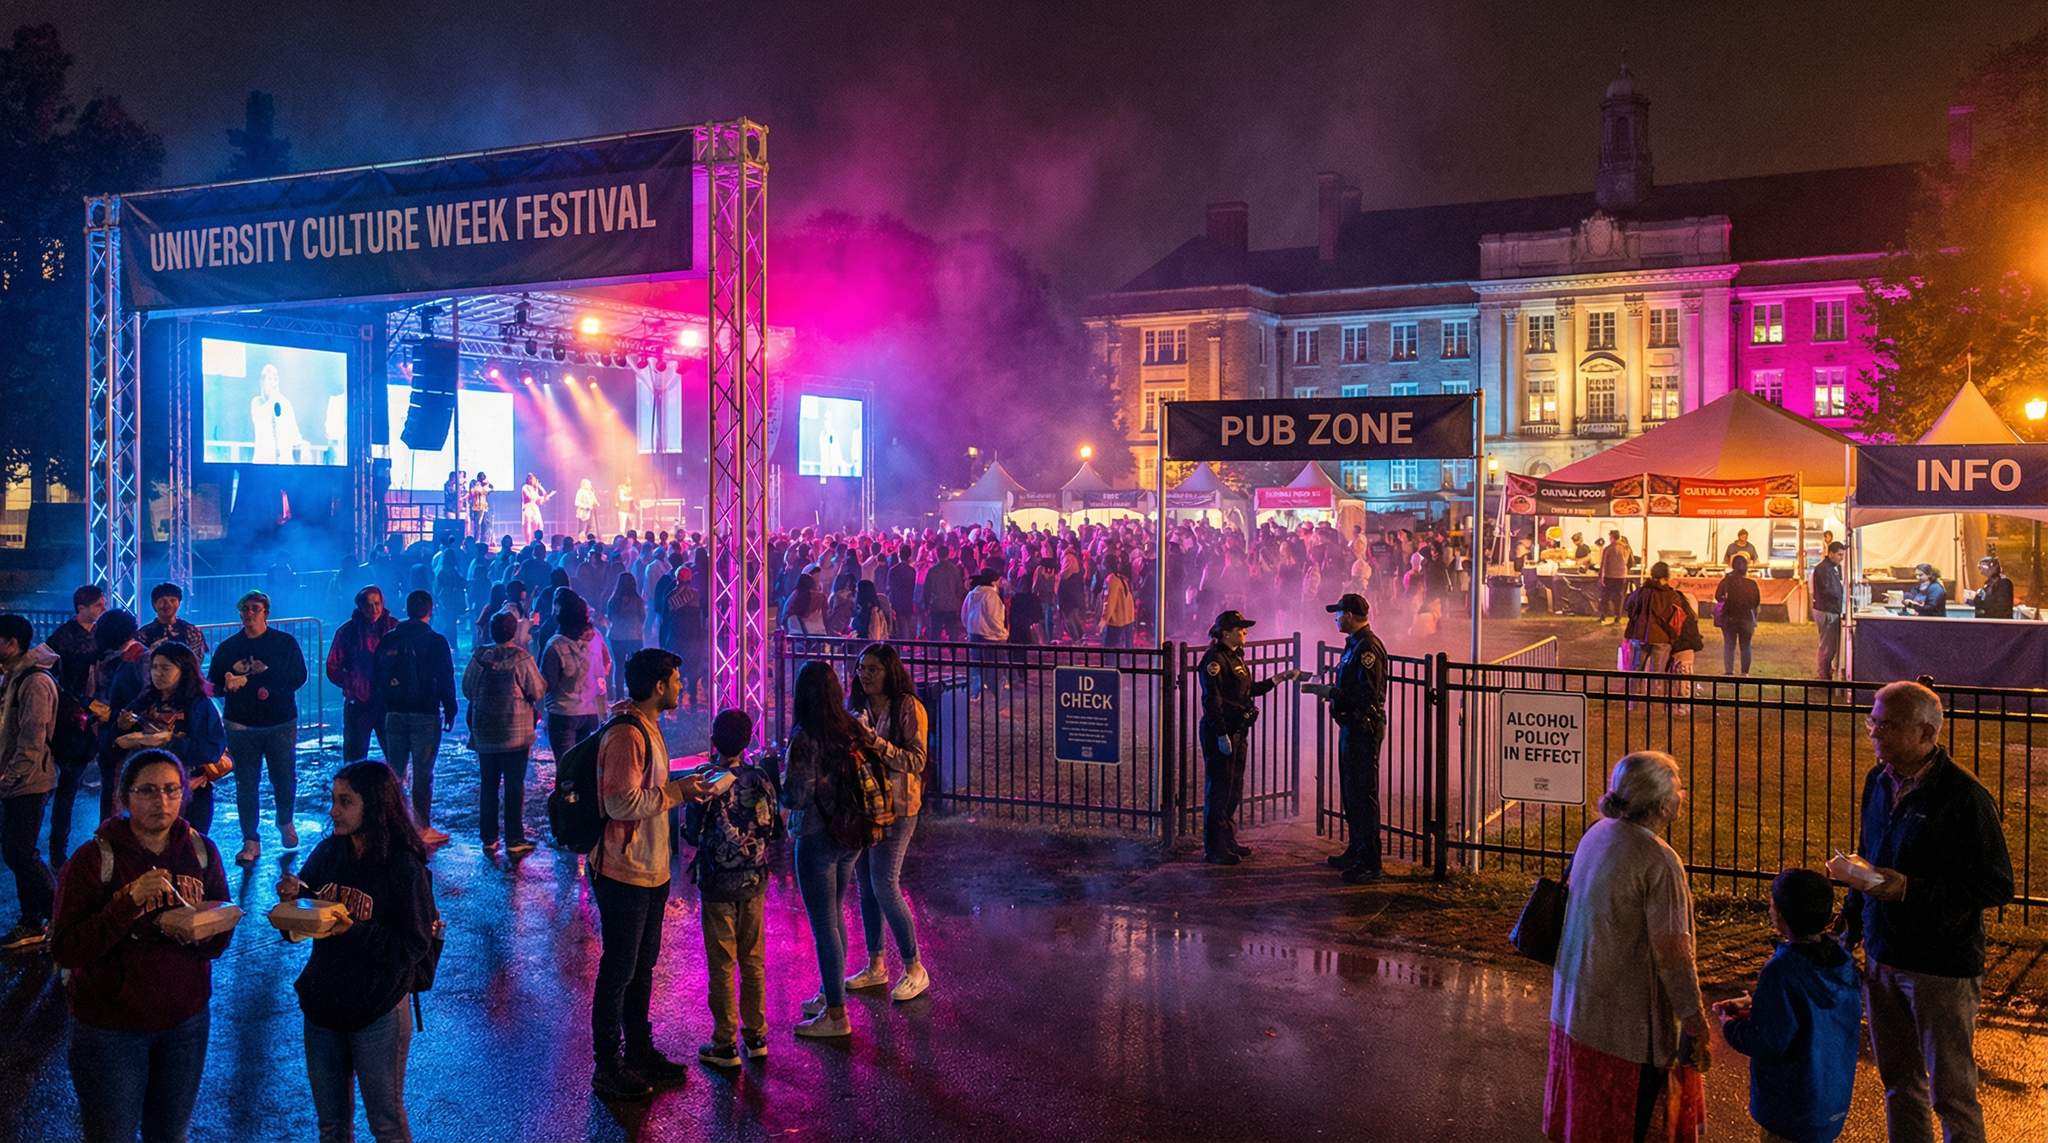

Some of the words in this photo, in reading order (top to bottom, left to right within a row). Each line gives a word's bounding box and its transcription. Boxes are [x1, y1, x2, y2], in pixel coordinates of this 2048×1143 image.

[150, 220, 295, 272] UNIVERSITY
[302, 207, 420, 260] CULTURE
[426, 197, 509, 248] WEEK
[516, 183, 657, 241] FESTIVAL
[1221, 415, 1296, 446] PUB
[1308, 411, 1414, 445] ZONE
[1917, 458, 2022, 492] INFO
[1684, 487, 1727, 496] CULTURAL
[1078, 675, 1094, 691] ID
[1061, 692, 1113, 710] CHECK
[1506, 711, 1578, 729] ALCOHOL
[1515, 730, 1570, 746] POLICY
[1504, 746, 1519, 760] IN
[1525, 747, 1581, 764] EFFECT
